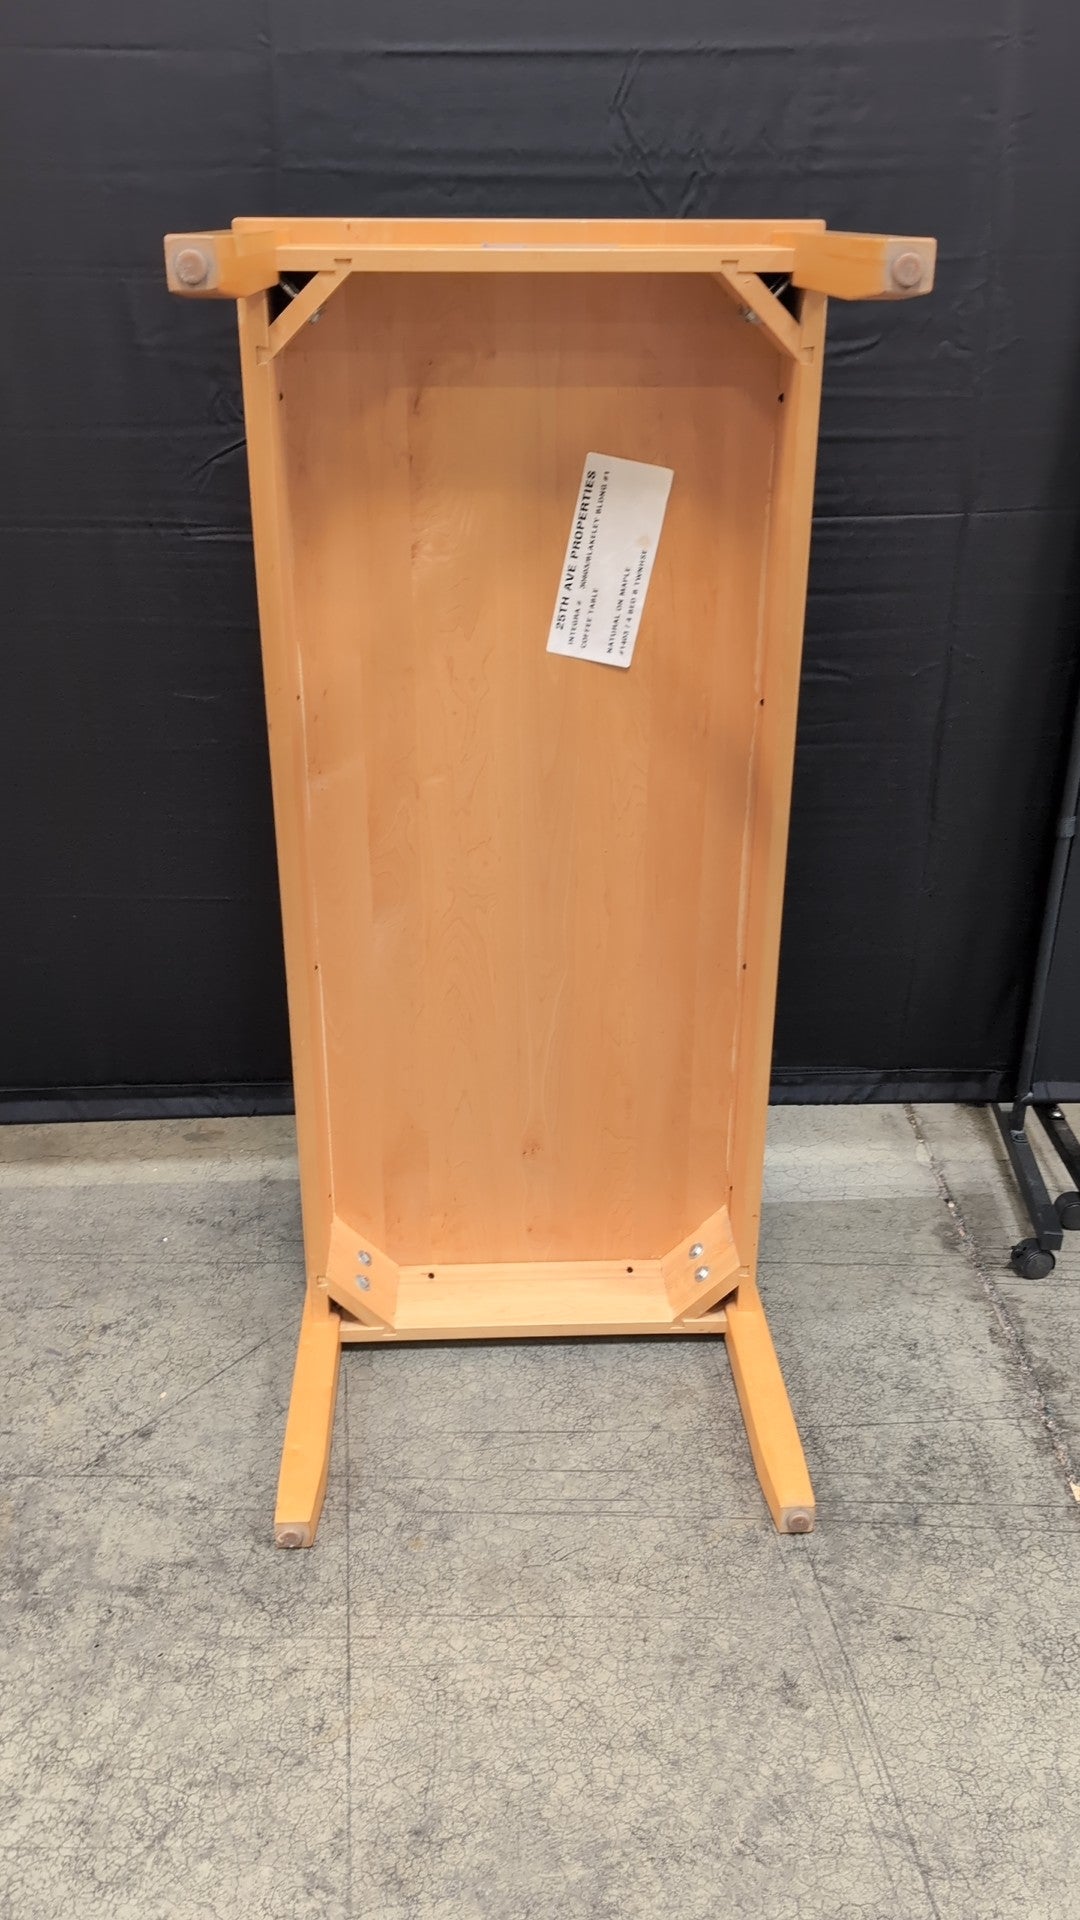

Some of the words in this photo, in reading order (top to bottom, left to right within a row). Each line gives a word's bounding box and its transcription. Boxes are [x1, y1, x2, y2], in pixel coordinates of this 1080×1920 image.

[556, 596, 570, 630] 25TH
[564, 565, 576, 591] AVE
[570, 471, 596, 559] PROPERTIES
[580, 618, 592, 648] COFFEE
[587, 588, 598, 613] TABLE
[606, 615, 620, 653] NATURAL
[619, 568, 630, 596] MAPLE
